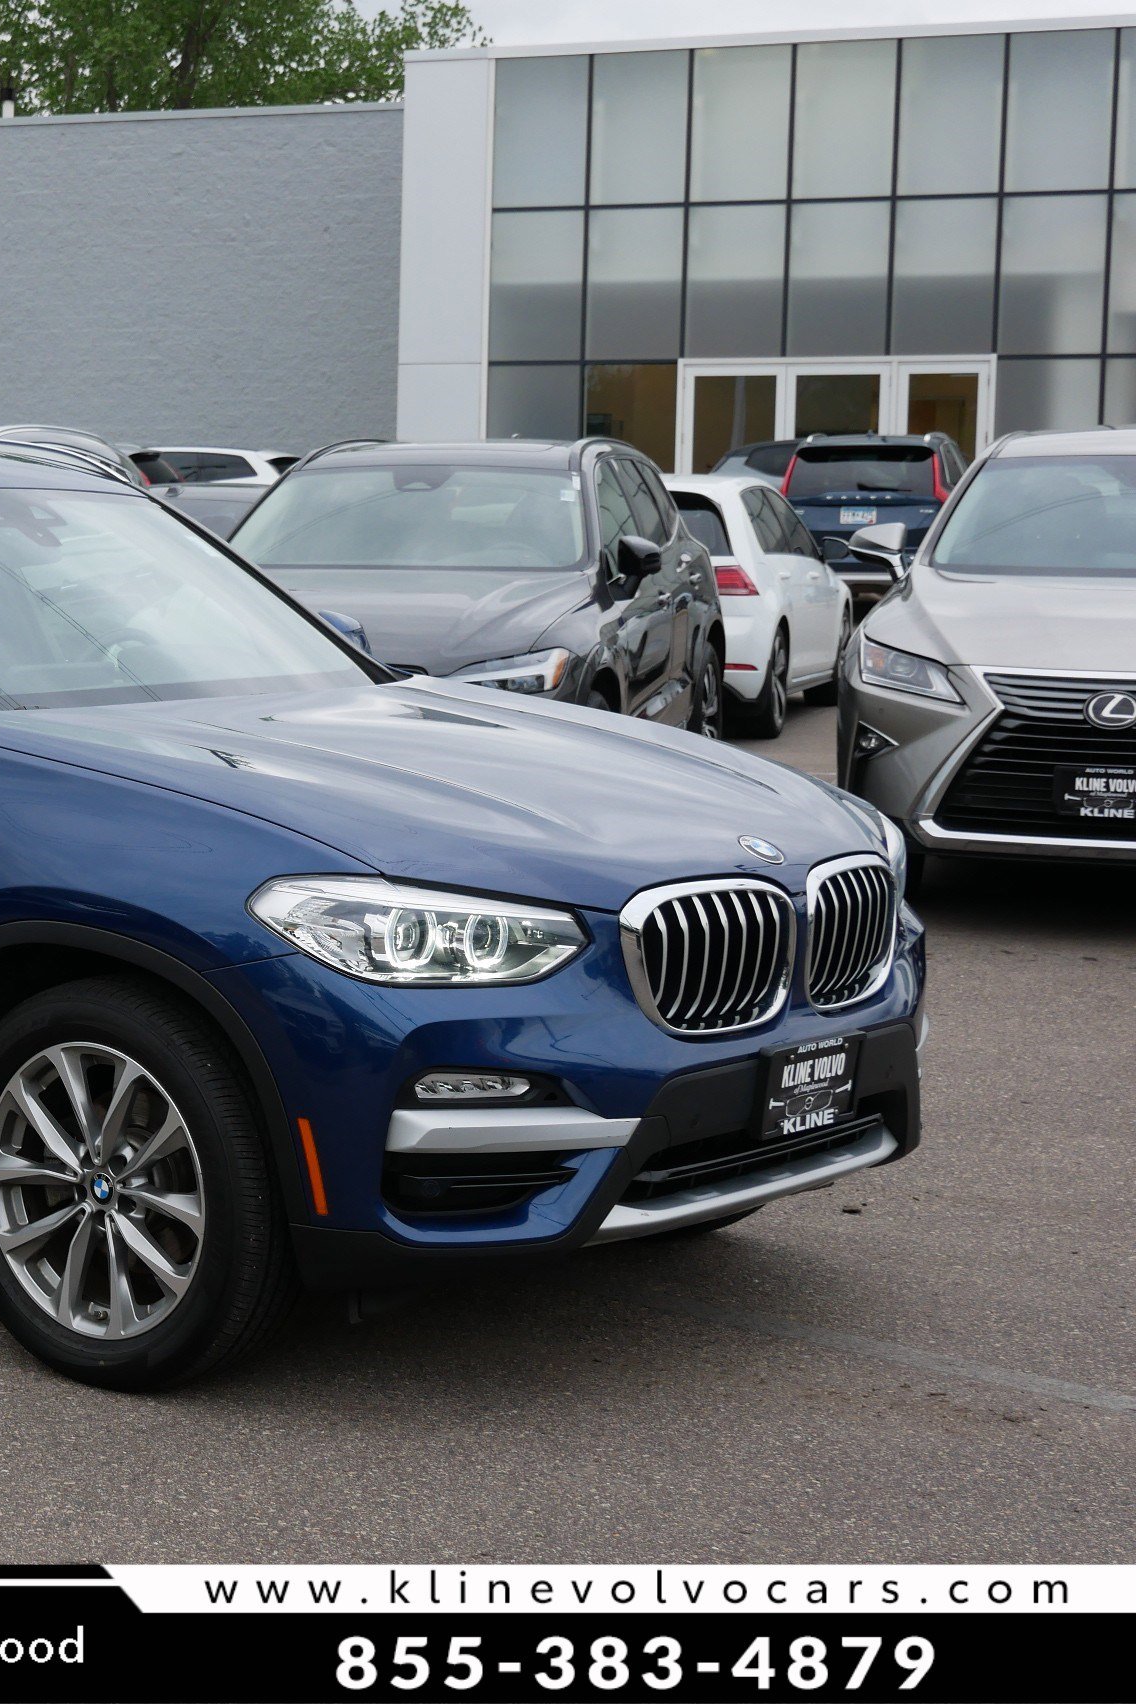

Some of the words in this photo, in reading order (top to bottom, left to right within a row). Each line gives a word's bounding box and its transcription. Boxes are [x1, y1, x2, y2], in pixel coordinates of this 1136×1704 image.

[1075, 776, 1107, 791] KLINE
[1108, 778, 1136, 793] VOLV
[1080, 807, 1135, 818] KLINE
[797, 1043, 817, 1053] AUTO
[818, 1038, 843, 1049] WORLD
[781, 1060, 813, 1088] KLINE
[813, 1052, 846, 1081] VOLVO
[783, 1109, 834, 1134] KLINE
